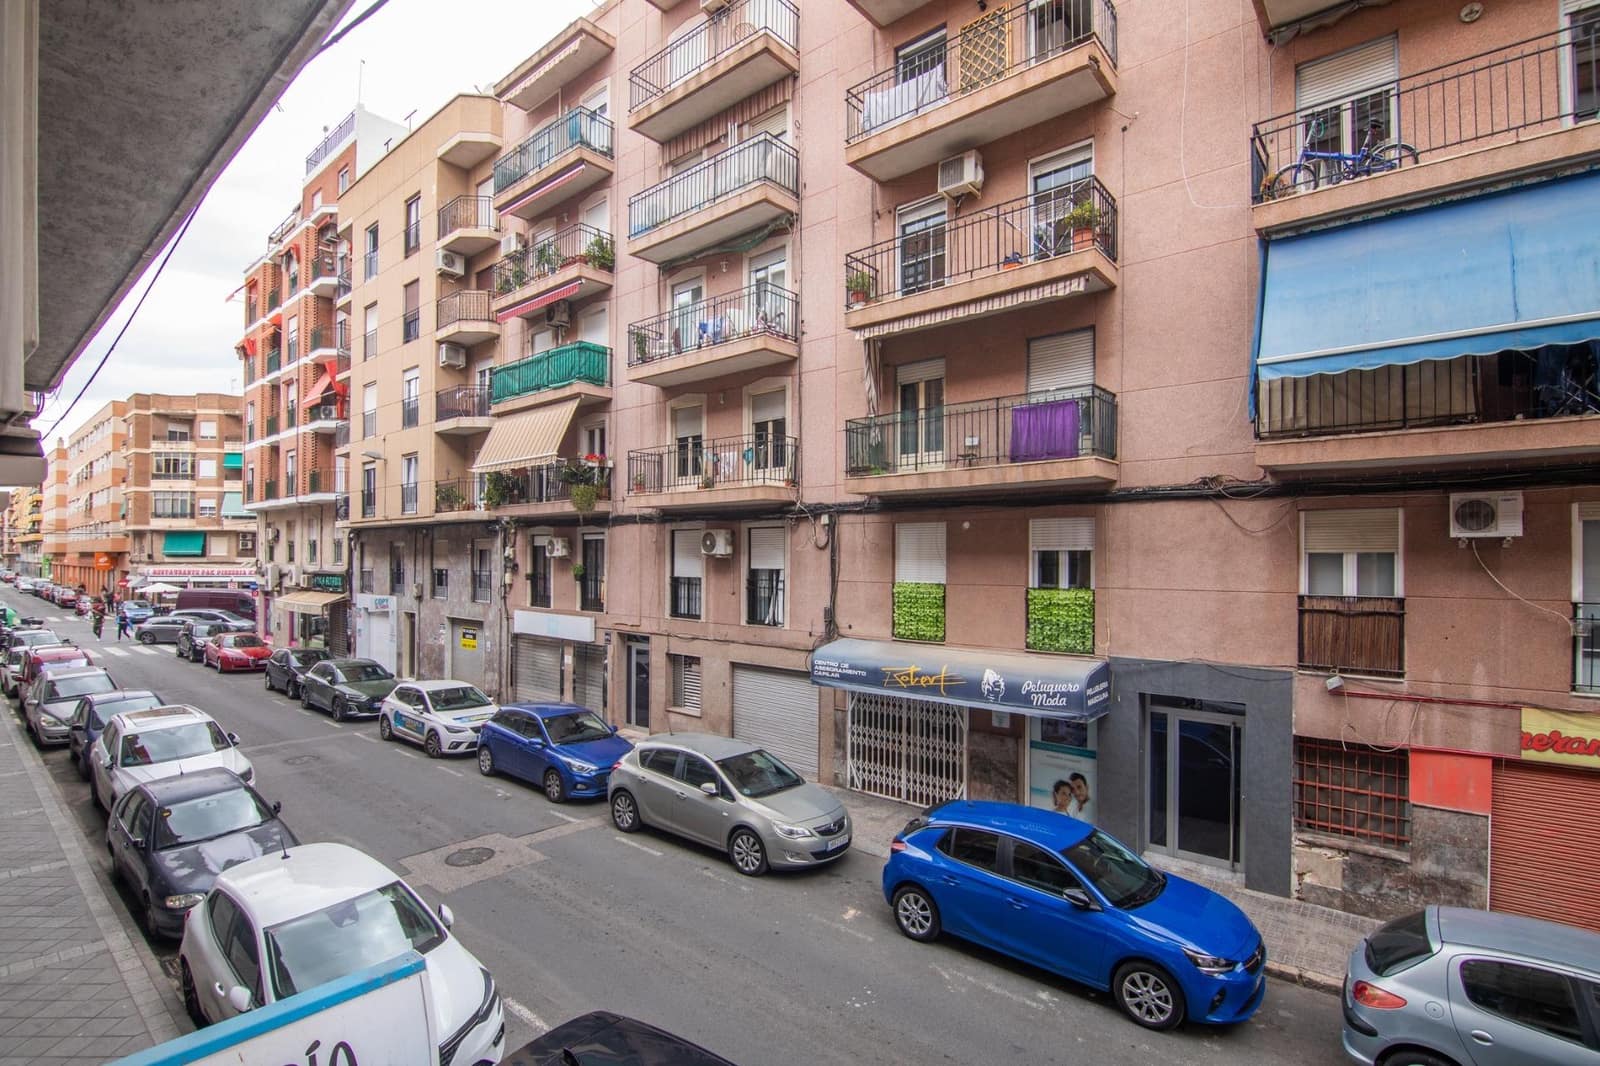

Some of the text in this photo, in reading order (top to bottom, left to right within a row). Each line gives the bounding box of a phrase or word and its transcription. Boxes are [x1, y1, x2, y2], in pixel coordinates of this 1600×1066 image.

[813, 670, 840, 678] CAPILAR
[814, 665, 867, 677] ASESORAMIENTO
[1021, 680, 1080, 696] Peluquero
[1030, 693, 1067, 706] Moda
